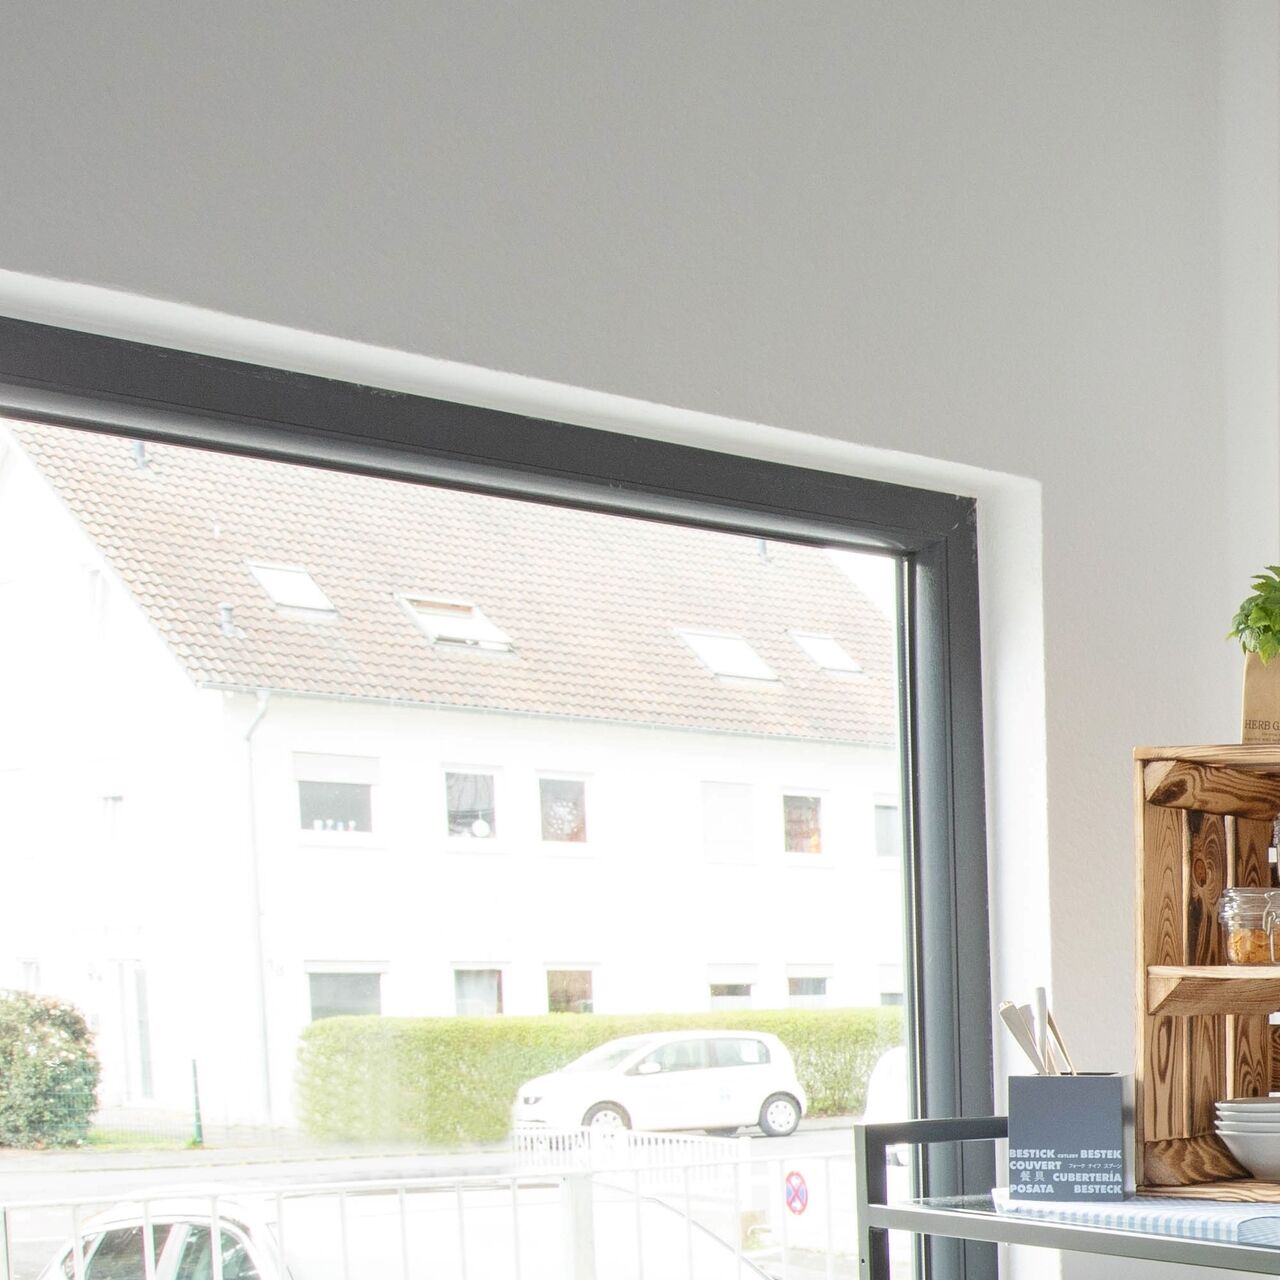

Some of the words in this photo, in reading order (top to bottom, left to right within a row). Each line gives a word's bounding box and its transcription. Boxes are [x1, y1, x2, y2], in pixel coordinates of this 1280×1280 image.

[1245, 720, 1270, 730] HERB
[1009, 1149, 1055, 1158] BESTICK
[1080, 1149, 1122, 1159] BESTEK
[1010, 1161, 1061, 1170] COUVERT
[1053, 1171, 1122, 1182] CUBERTERÍA
[1010, 1184, 1054, 1193] POSATA
[1074, 1184, 1122, 1194] BESTECK
